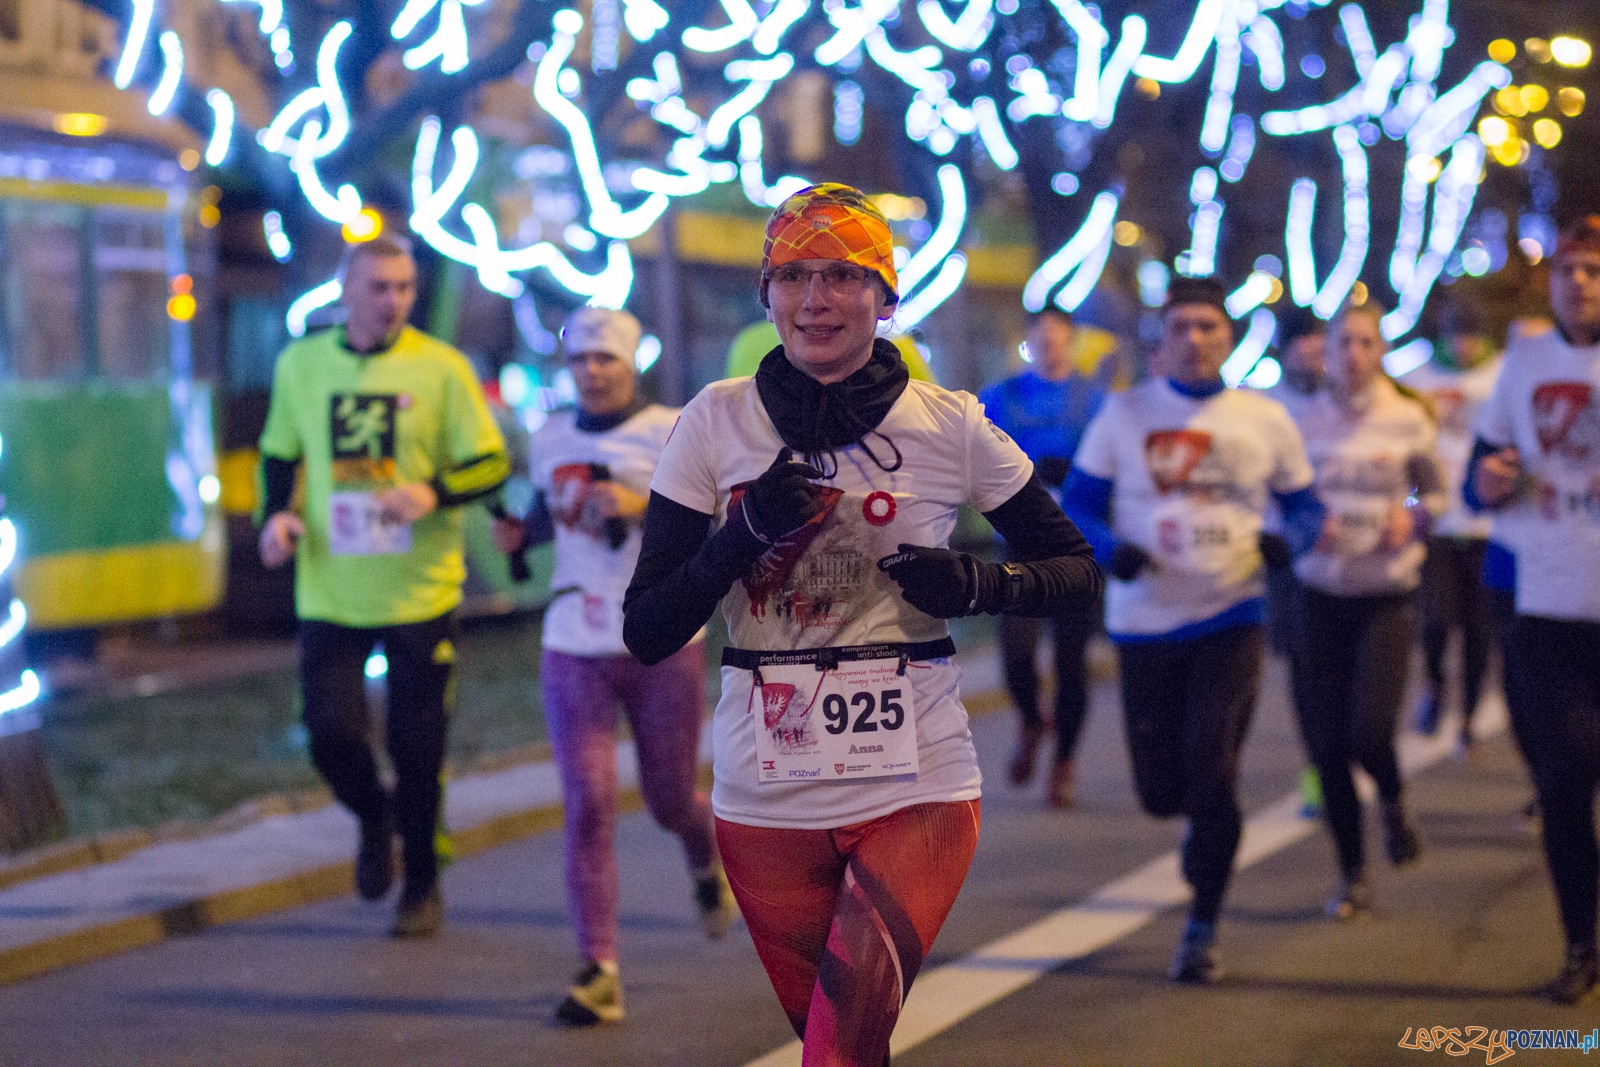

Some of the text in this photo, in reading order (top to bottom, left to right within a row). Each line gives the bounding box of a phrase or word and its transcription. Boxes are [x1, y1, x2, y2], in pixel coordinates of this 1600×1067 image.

[883, 553, 910, 568] CRAFT
[760, 653, 818, 663] performance
[857, 650, 899, 659] anti-shock
[822, 689, 905, 735] 925
[848, 744, 884, 755] Anna
